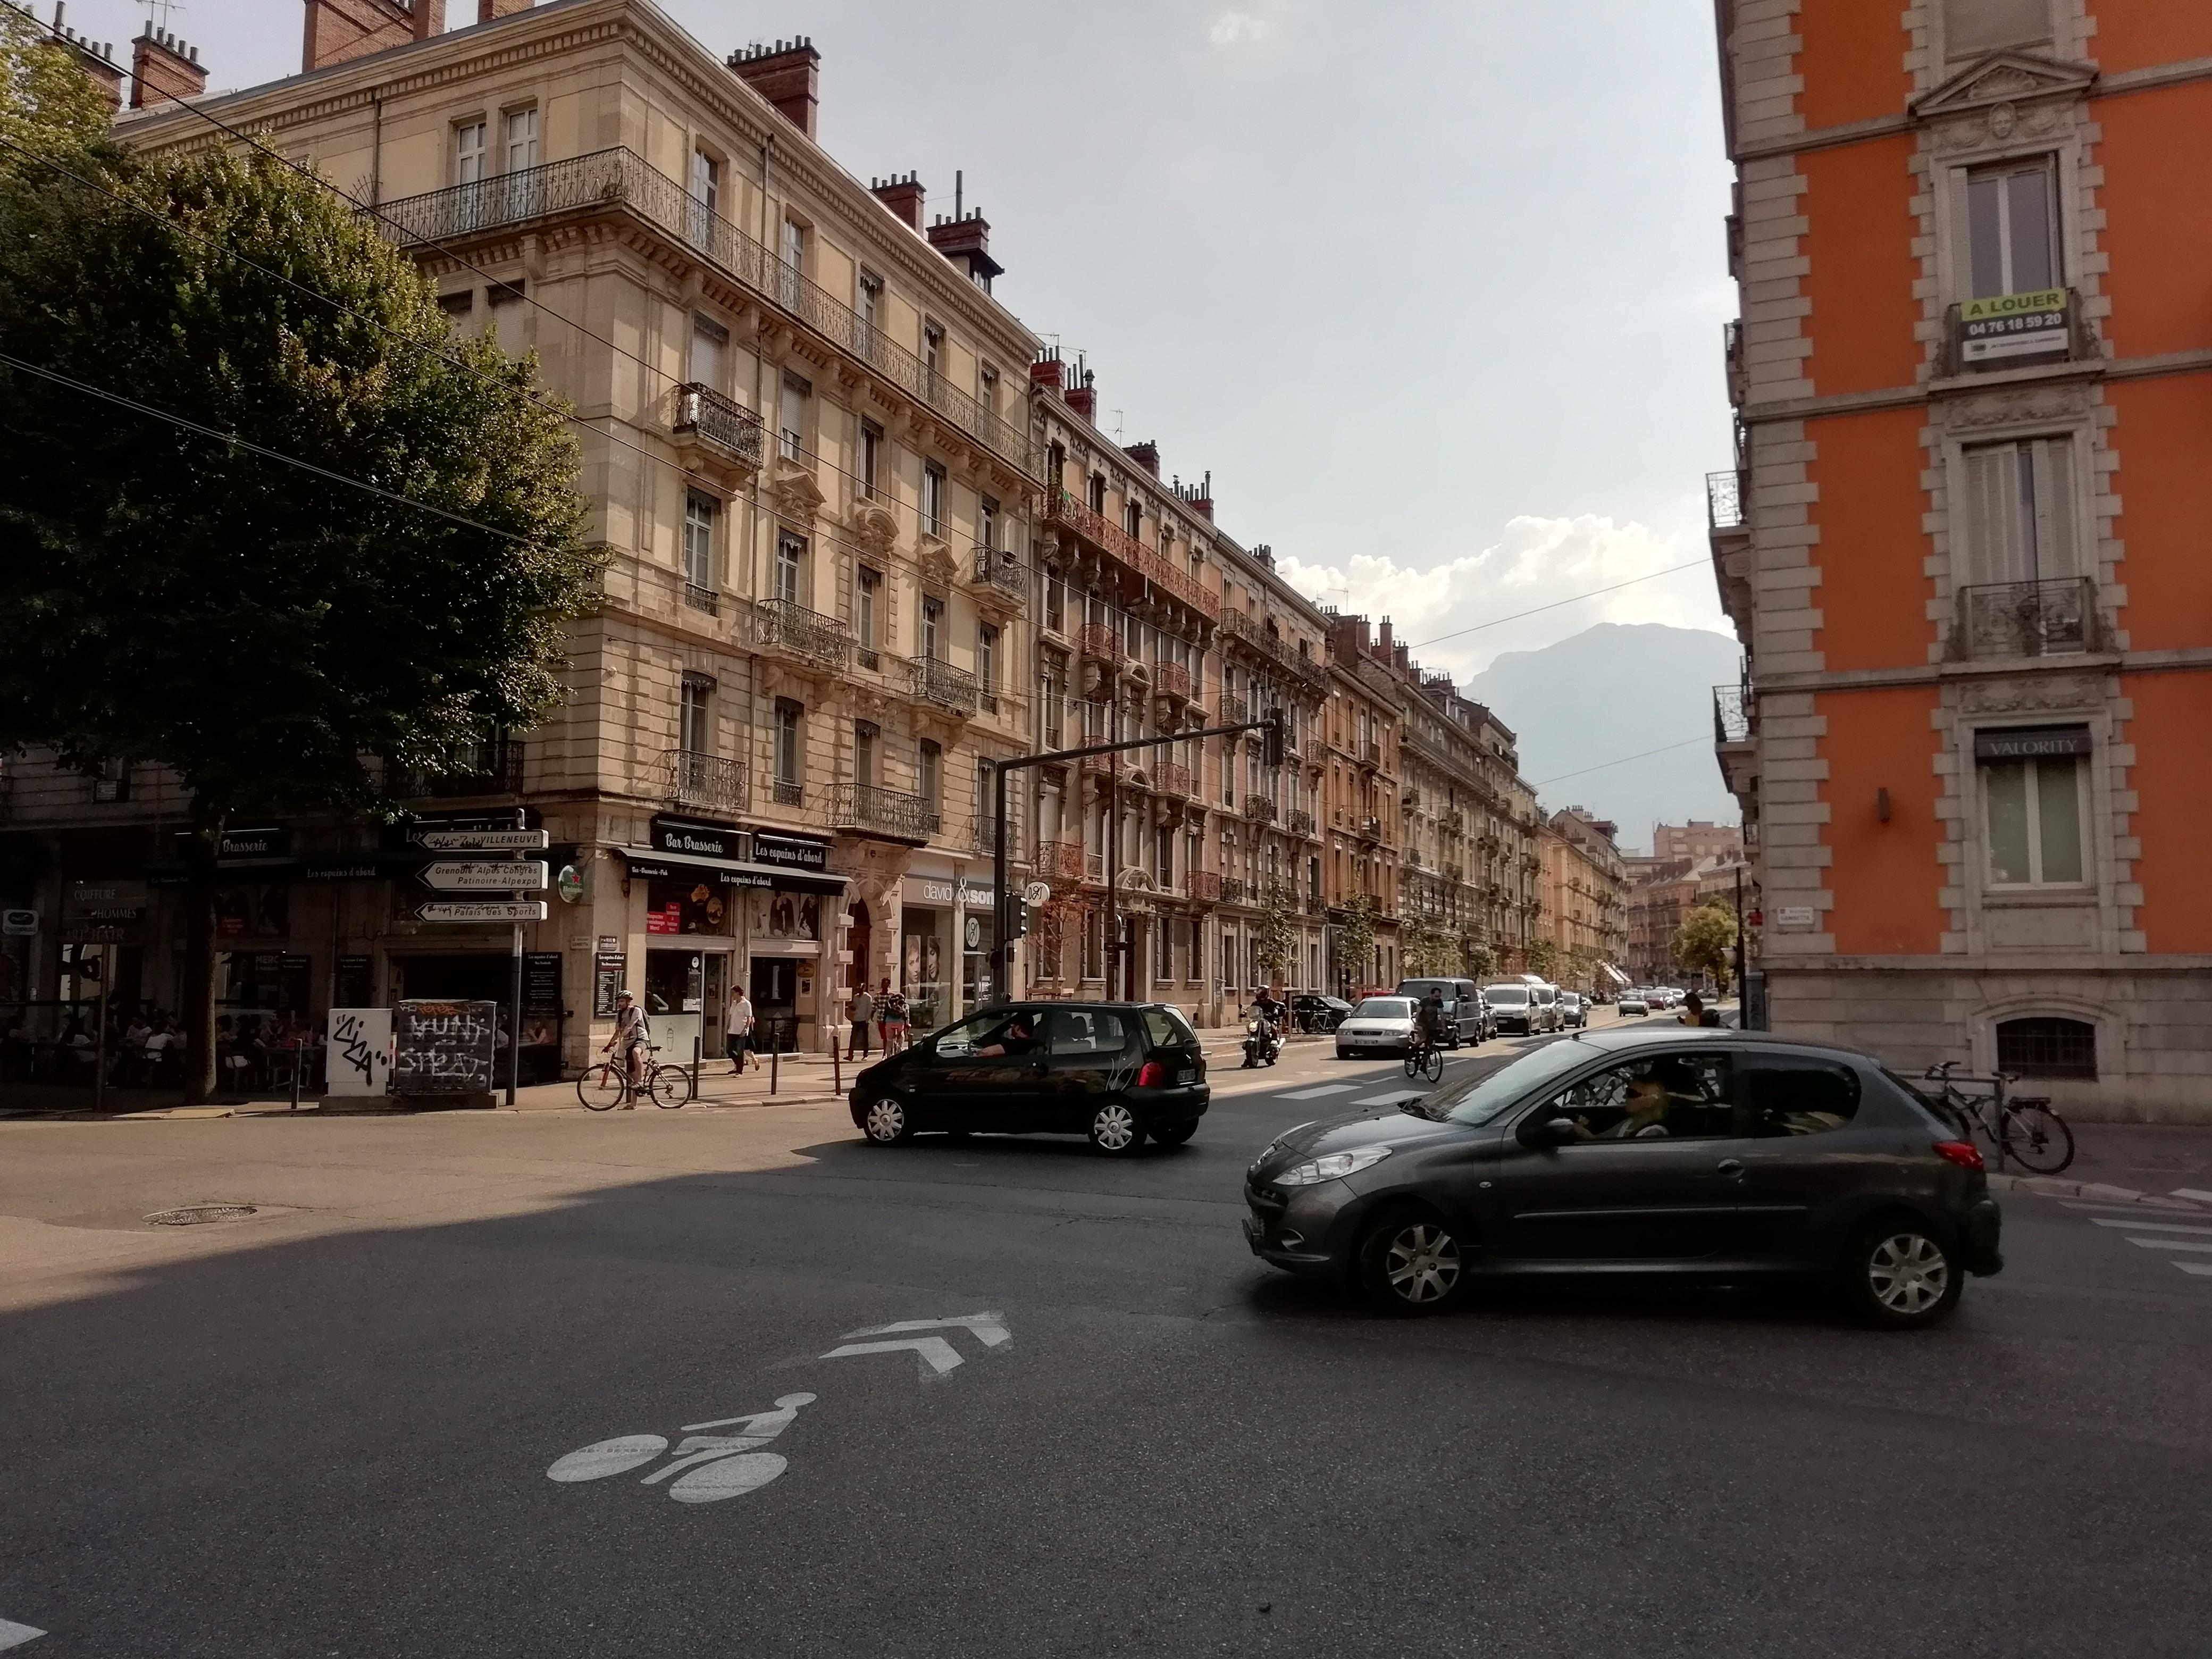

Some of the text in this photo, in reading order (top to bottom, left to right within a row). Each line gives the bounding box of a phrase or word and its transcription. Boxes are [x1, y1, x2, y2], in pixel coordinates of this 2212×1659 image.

[1970, 293, 2059, 315] A LOUER
[1968, 313, 2062, 336] 04 76 18 59 20
[1990, 739, 2077, 755] VALORITY
[222, 839, 269, 852] Brasserie
[481, 835, 538, 844] VILLENEUVE
[665, 833, 724, 853] Bar Brasserie
[756, 842, 823, 864] Les copains d'abord
[307, 866, 376, 880] Les copains d'abord
[435, 866, 472, 875] Grenoble
[477, 866, 500, 876] Alpes
[720, 873, 772, 887] Les copains d'abord
[74, 889, 116, 901] COIFFURE
[923, 881, 952, 901] david
[97, 908, 137, 919] HOMMES
[507, 908, 537, 917] Sports
